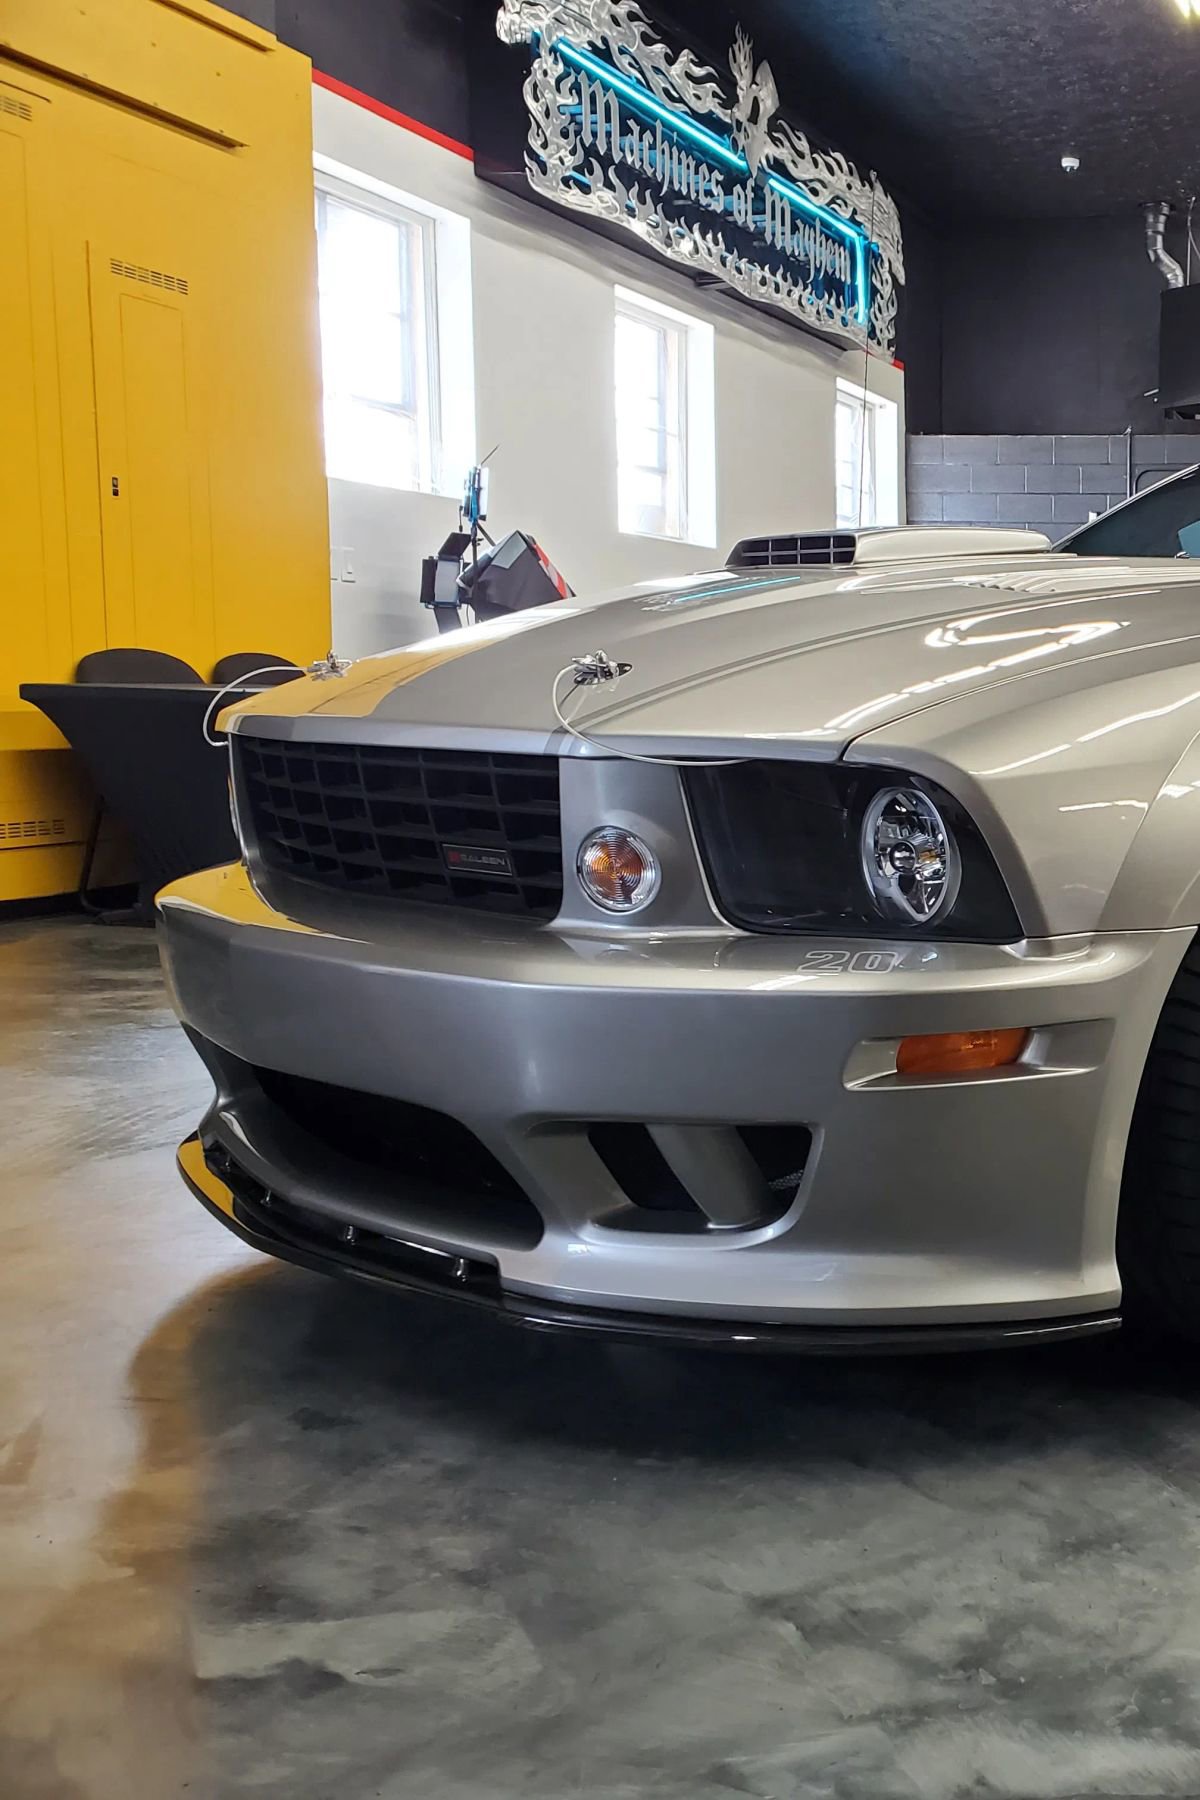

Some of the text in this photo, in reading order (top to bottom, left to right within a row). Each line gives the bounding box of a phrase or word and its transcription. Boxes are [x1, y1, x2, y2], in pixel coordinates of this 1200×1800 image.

[578, 70, 851, 284] Machines of Mayhem
[796, 950, 899, 974] 20
